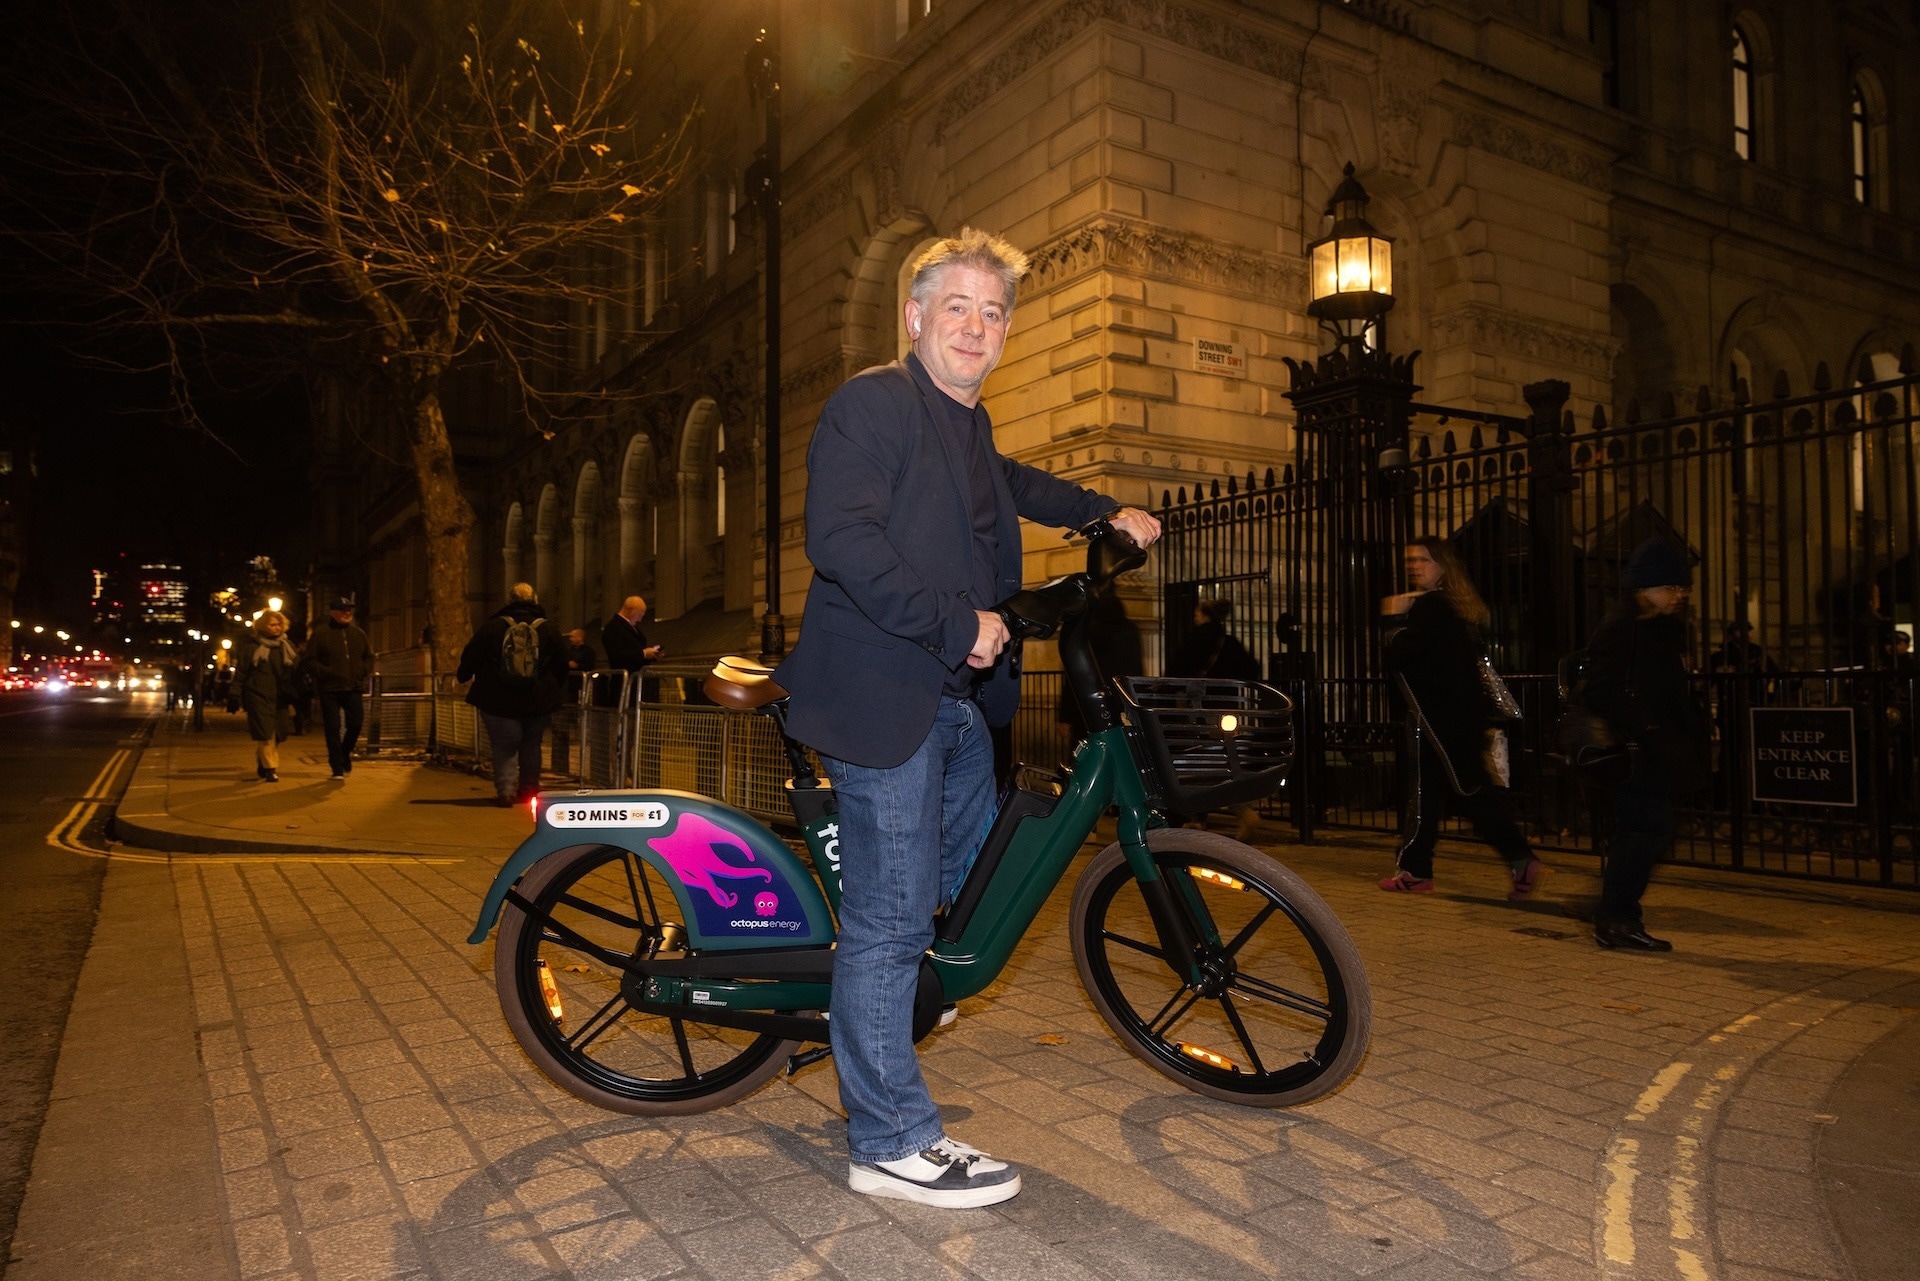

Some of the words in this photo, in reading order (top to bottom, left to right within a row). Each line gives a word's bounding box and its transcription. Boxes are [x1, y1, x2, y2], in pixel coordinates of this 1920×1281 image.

[1199, 340, 1233, 354] DOWNING
[1198, 351, 1225, 364] STREET
[1227, 356, 1242, 367] SW1
[1780, 730, 1825, 744] KEEP
[1757, 748, 1850, 764] ENTRANCE
[1773, 766, 1831, 781] CLEAR
[568, 810, 587, 821] 30
[589, 810, 628, 821] MINS
[648, 810, 662, 820] £1
